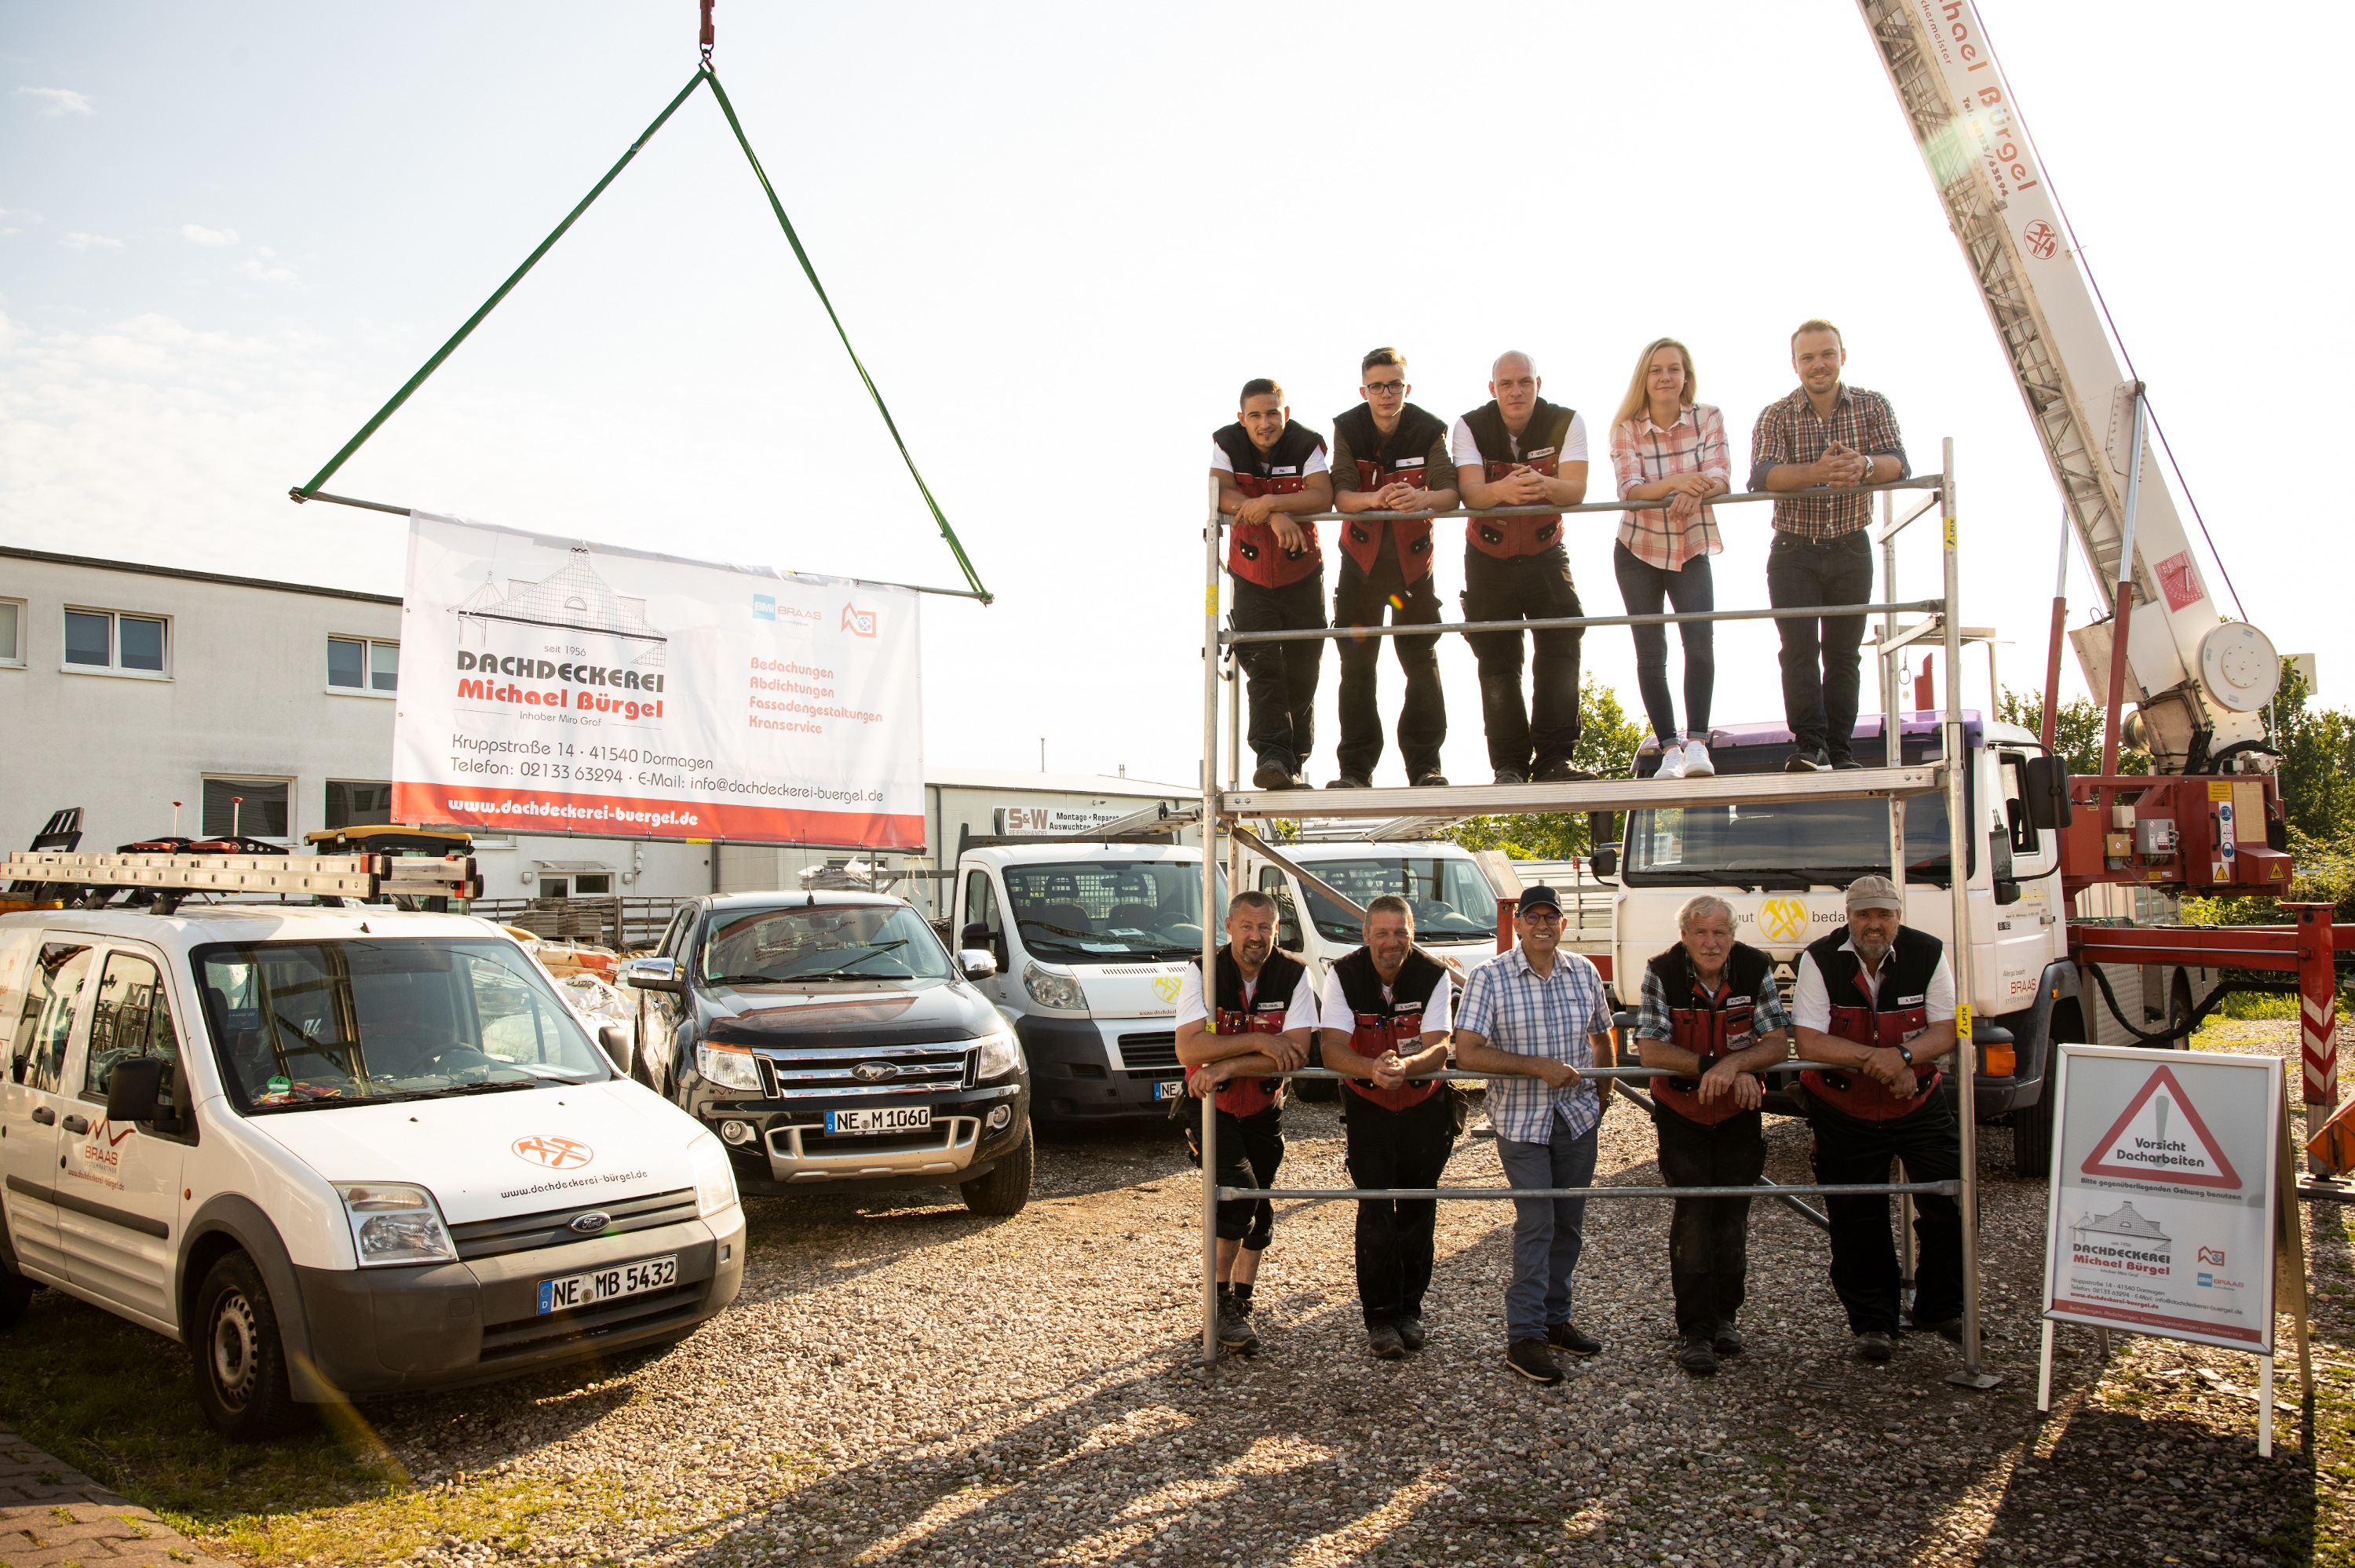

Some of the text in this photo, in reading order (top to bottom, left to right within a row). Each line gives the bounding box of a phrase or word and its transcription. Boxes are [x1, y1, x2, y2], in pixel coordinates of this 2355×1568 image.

[1921, 0, 1952, 64] ckermeister
[1939, 0, 2037, 191] hael Bürgel
[1962, 97, 1974, 117] Tel.
[754, 601, 822, 620] BMI BRAAS
[778, 618, 809, 627] SystemPartner
[544, 645, 586, 656] seit 1956
[457, 651, 664, 693] DACHDECKEREI
[750, 657, 834, 680] Bedachungen
[750, 676, 834, 699] Abdichtungen
[457, 678, 663, 720] Michael Bürgel
[520, 711, 602, 727] Inhaber Miro Graf
[750, 695, 883, 724] Fassadengestaltungen
[749, 715, 823, 735] Kranservice
[452, 733, 714, 771] Kruppstraße 14 41540 Dormagen
[451, 757, 884, 804] Telefon: 02133 63294 E-Mail: info@dachdeckerei-buergel.de
[447, 798, 698, 827] www.dachdeckerei-buergel.de
[1009, 808, 1049, 830] S&W
[1057, 812, 1086, 821] Montage
[1049, 822, 1091, 830] Auswuchten
[1738, 911, 1846, 923] ut beda
[2011, 979, 2036, 994] BRAAS
[2005, 994, 2034, 1005] SYSTEMPARTNER
[1162, 1084, 1177, 1096] NE
[837, 1113, 860, 1130] NE
[872, 1111, 882, 1128] M
[886, 1109, 928, 1127] 1060
[2135, 1137, 2186, 1152] Vorsicht
[85, 1145, 118, 1165] BRAAS
[2116, 1149, 2204, 1167] Dacharbeiten
[84, 1160, 117, 1173] SYSTEMPARTNER
[501, 1170, 648, 1198] www.dachdeckerei-bürgel.de
[2099, 1180, 2171, 1193] gegenüberliegenden
[2173, 1187, 2205, 1198] Gehweg
[2207, 1191, 2242, 1200] benutzen
[582, 1216, 602, 1229] Ford
[2072, 1243, 2171, 1264] DACHDECKEREI
[2073, 1254, 2170, 1275] Michael Bürgel
[542, 1260, 674, 1309] D NE MB 5432
[2071, 1278, 2104, 1287] Kruppstraße
[2136, 1287, 2165, 1296] Dormagen
[2213, 1278, 2244, 1288] BRAAS
[2070, 1292, 2159, 1309] www.dachdeckerei-buergel.de
[2156, 1297, 2243, 1315] info@dachdeckerei-buergel.de
[2141, 1316, 2199, 1330] Fassadengestaltungen
[2211, 1328, 2243, 1337] Kranservice
